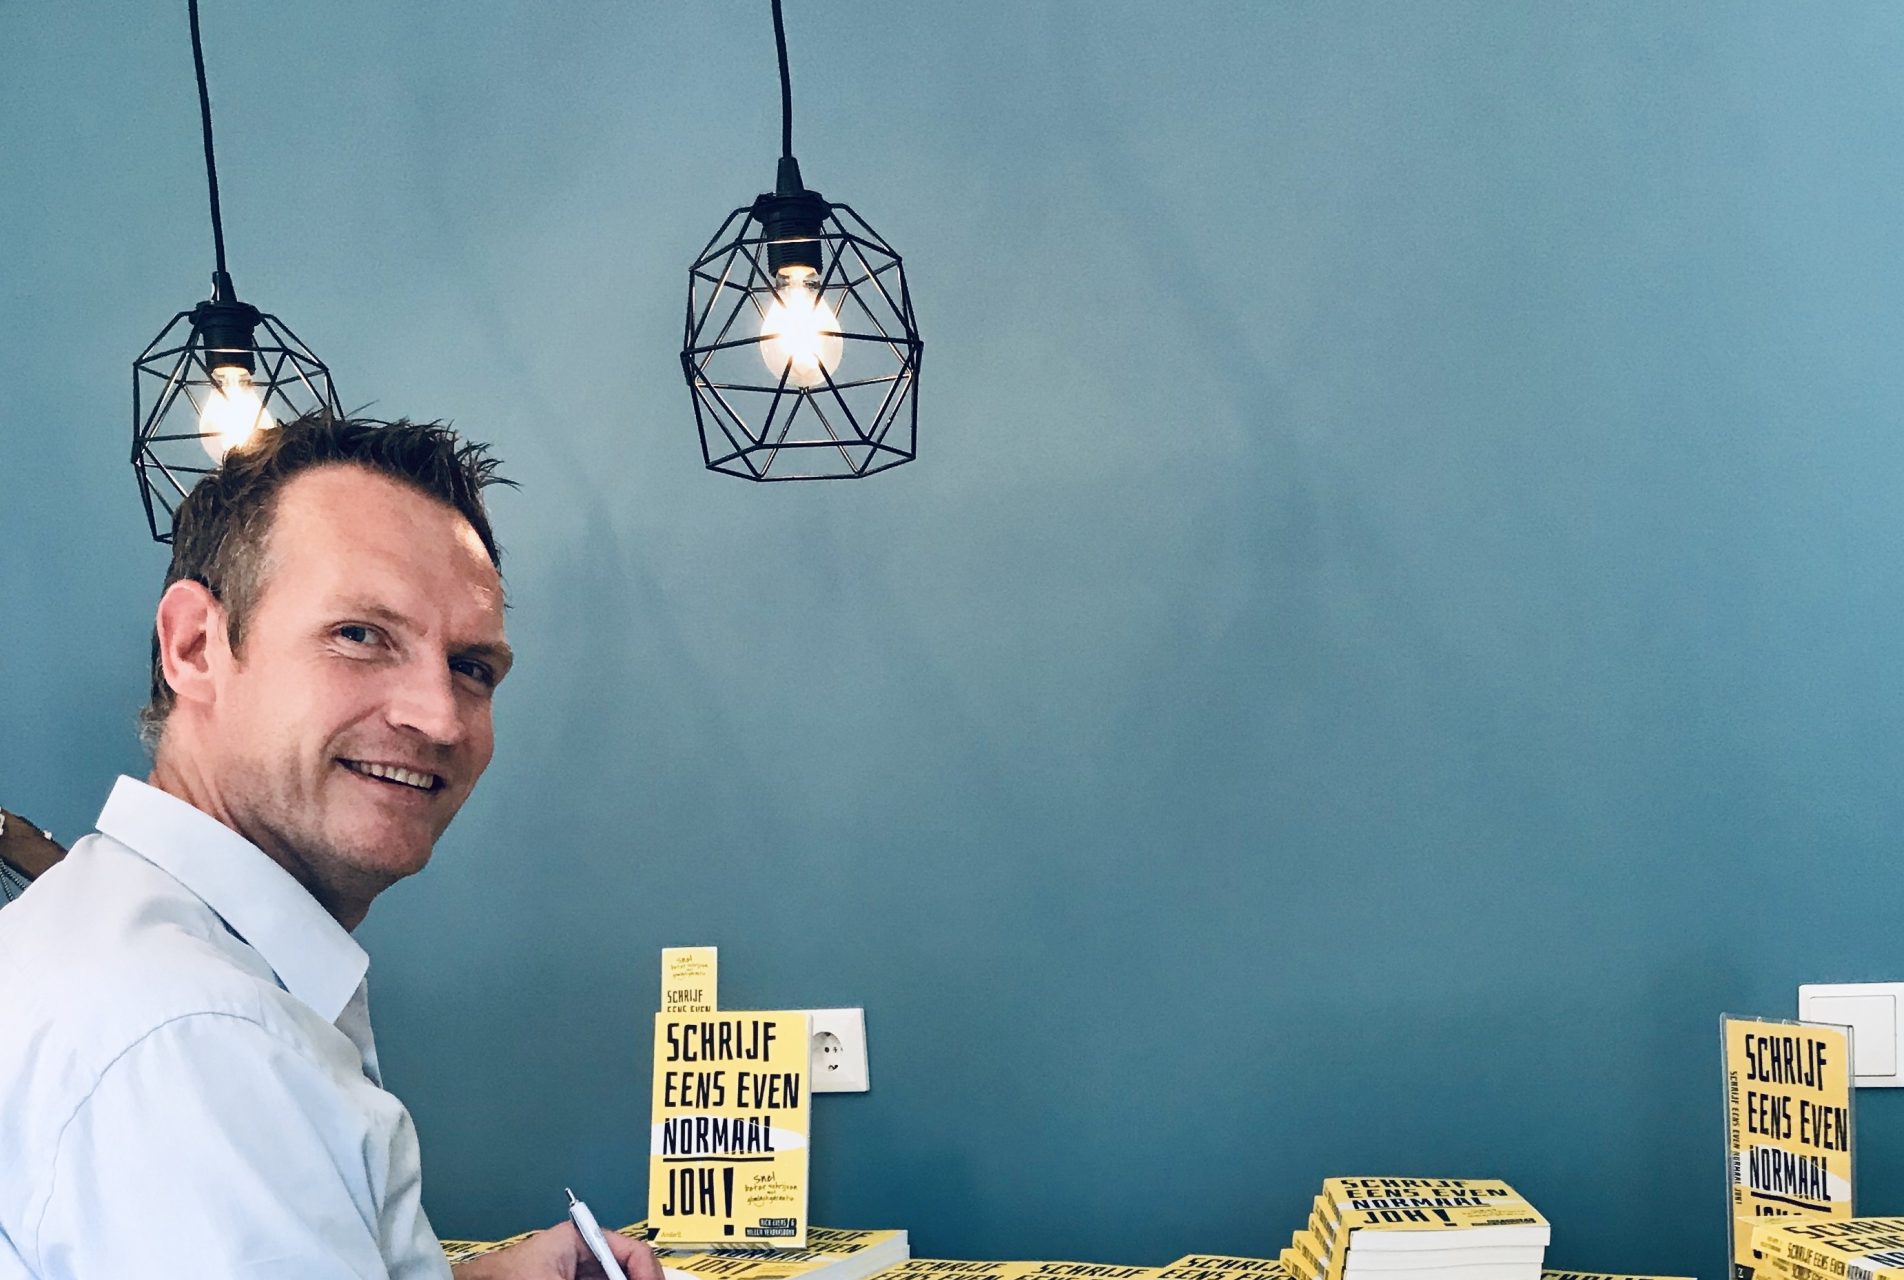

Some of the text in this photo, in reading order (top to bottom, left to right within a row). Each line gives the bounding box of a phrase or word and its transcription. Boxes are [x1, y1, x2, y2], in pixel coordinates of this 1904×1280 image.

[667, 989, 703, 1004] SCHRIJF
[666, 1020, 776, 1062] SCHRIJF
[1745, 1033, 1827, 1091] SCHRIJF
[664, 1071, 800, 1109] EENS EVEN
[1748, 1091, 1848, 1152] EENS EVEN
[663, 1116, 775, 1155] NORMAAL
[1340, 1178, 1469, 1189] SCHRIJF
[1750, 1145, 1832, 1202] NORMAAL
[662, 1167, 734, 1236] JOH!
[1346, 1188, 1507, 1198] EENS EVEN
[1352, 1197, 1490, 1210] NORMAAL
[1363, 1208, 1458, 1226] JOH!
[676, 1258, 762, 1280] JOH!
[895, 1260, 1007, 1273] SCHRIJF
[1030, 1263, 1150, 1278] SCHRIJF
[1157, 1268, 1233, 1280] EENS
